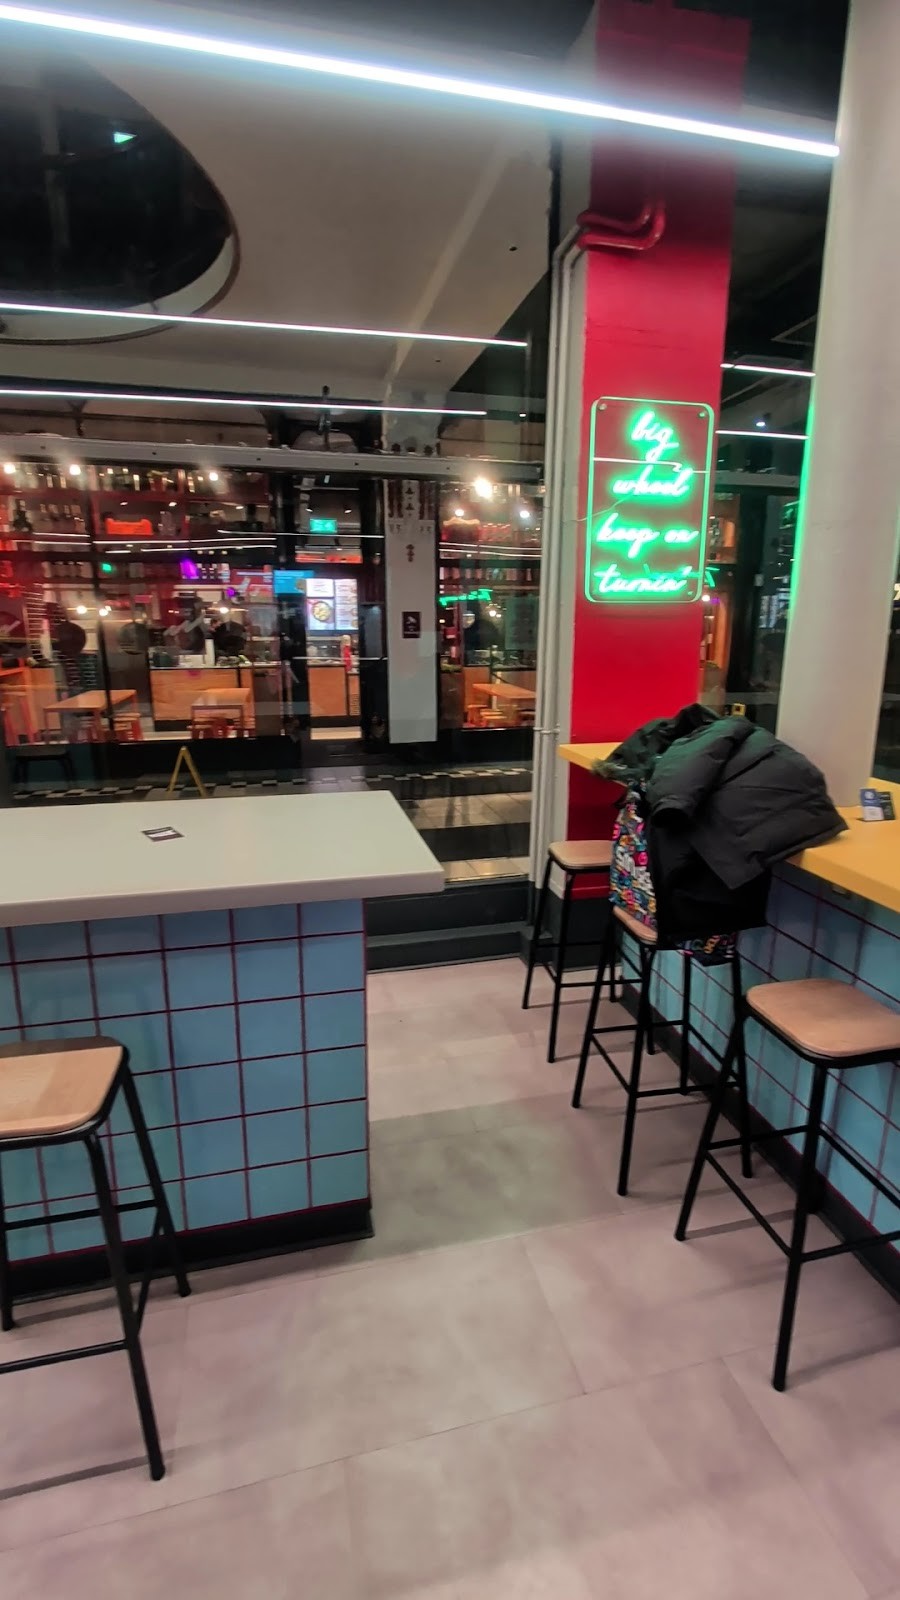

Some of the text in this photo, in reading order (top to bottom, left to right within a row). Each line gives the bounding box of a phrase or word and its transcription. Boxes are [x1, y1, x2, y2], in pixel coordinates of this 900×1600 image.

[631, 410, 679, 463] big
[612, 464, 694, 497] wheel
[596, 512, 699, 559] keep on
